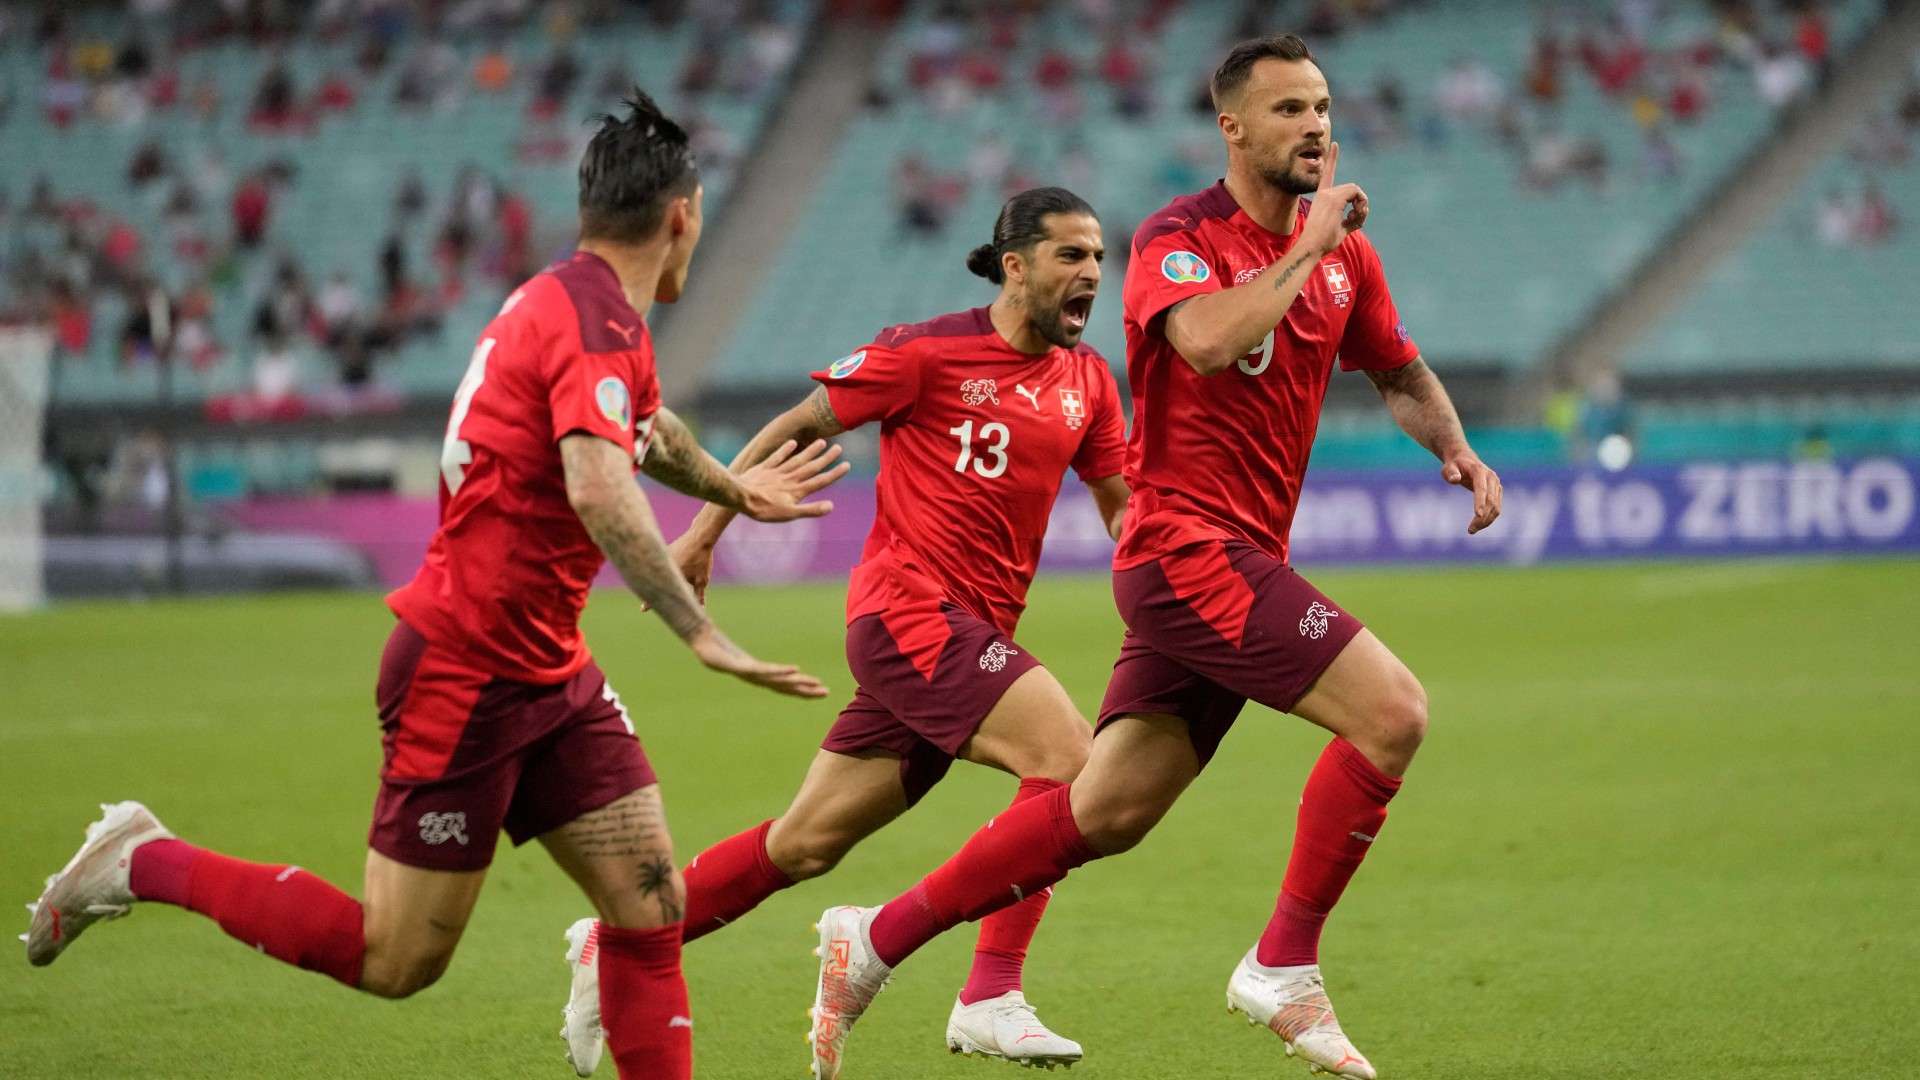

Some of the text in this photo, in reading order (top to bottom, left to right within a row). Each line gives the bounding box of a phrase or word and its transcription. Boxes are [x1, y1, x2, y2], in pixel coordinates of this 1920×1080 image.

[950, 419, 1011, 479] 13
[1571, 468, 1665, 546] to
[1677, 457, 1914, 541] ZERO
